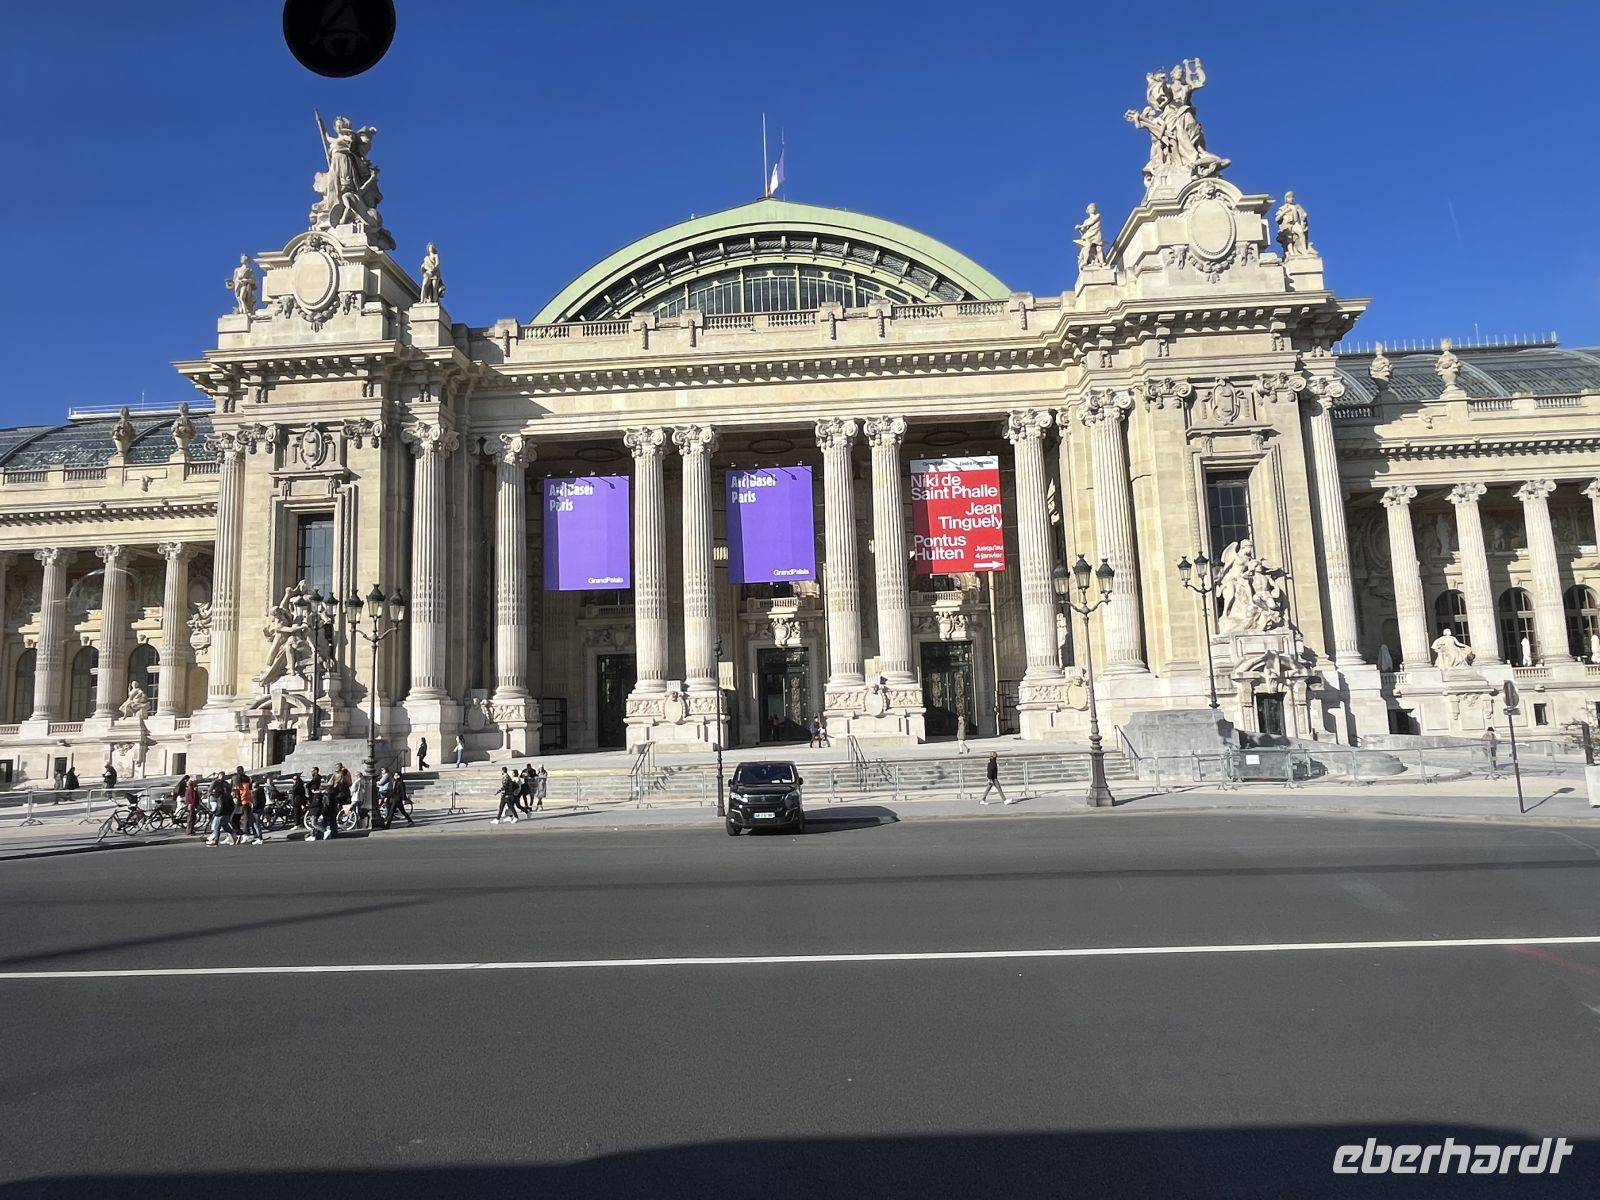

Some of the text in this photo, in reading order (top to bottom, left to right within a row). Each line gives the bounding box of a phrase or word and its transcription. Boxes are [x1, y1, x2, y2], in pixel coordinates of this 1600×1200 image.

[911, 473, 961, 488] Niki de
[731, 491, 757, 503] Paris
[912, 484, 998, 500] Saint Phalle
[549, 499, 574, 512] Paris
[965, 502, 1002, 516] Jean
[937, 514, 1003, 532] Tinguely
[914, 534, 967, 547] Pontus
[914, 546, 965, 560] Hulten
